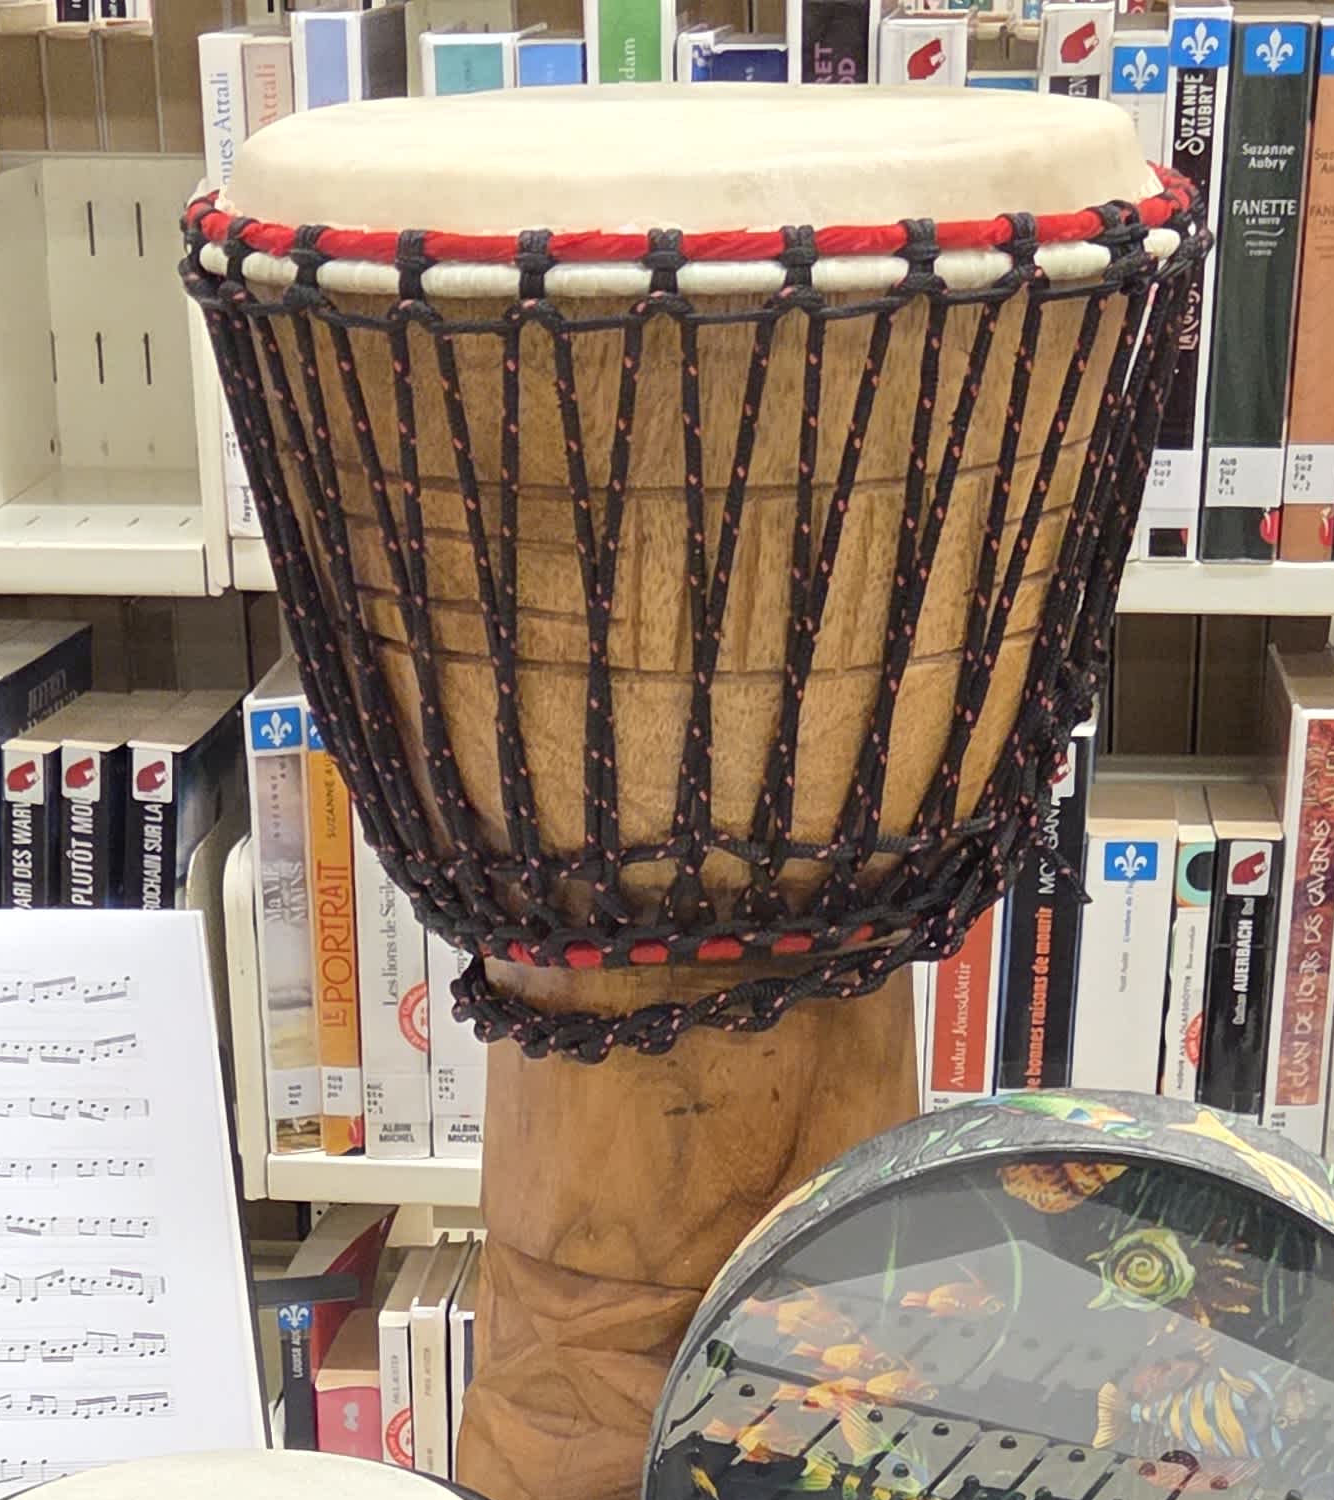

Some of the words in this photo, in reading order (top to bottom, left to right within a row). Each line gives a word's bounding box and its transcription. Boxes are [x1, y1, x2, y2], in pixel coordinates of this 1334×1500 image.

[213, 71, 234, 130] Attali
[1174, 74, 1204, 155] SUZANNE
[1197, 85, 1214, 137] AUBRY
[1242, 143, 1295, 156] Suzanne
[1232, 200, 1297, 216] FANETTE
[241, 486, 252, 522] fayard
[145, 803, 163, 823] LA
[327, 776, 336, 839] SUZANNE
[144, 825, 163, 854] SUR
[12, 849, 33, 885] DES
[66, 838, 94, 906] PLUTÔT
[1307, 819, 1332, 907] CAVERNES
[316, 860, 354, 1003] PORTRAIT
[379, 921, 396, 939] de
[1035, 906, 1053, 955] mourir
[1304, 913, 1323, 945] DES
[380, 944, 398, 973] lions
[1033, 956, 1049, 975] de
[1232, 919, 1253, 993] AUERBACH
[382, 977, 399, 1008] Les
[1029, 976, 1048, 1025] raisons
[322, 1009, 348, 1029] LE
[1294, 1011, 1312, 1036] DE
[948, 1040, 970, 1088] Audur
[1027, 1026, 1045, 1075] bonnes
[1291, 1041, 1308, 1087] CLAN
